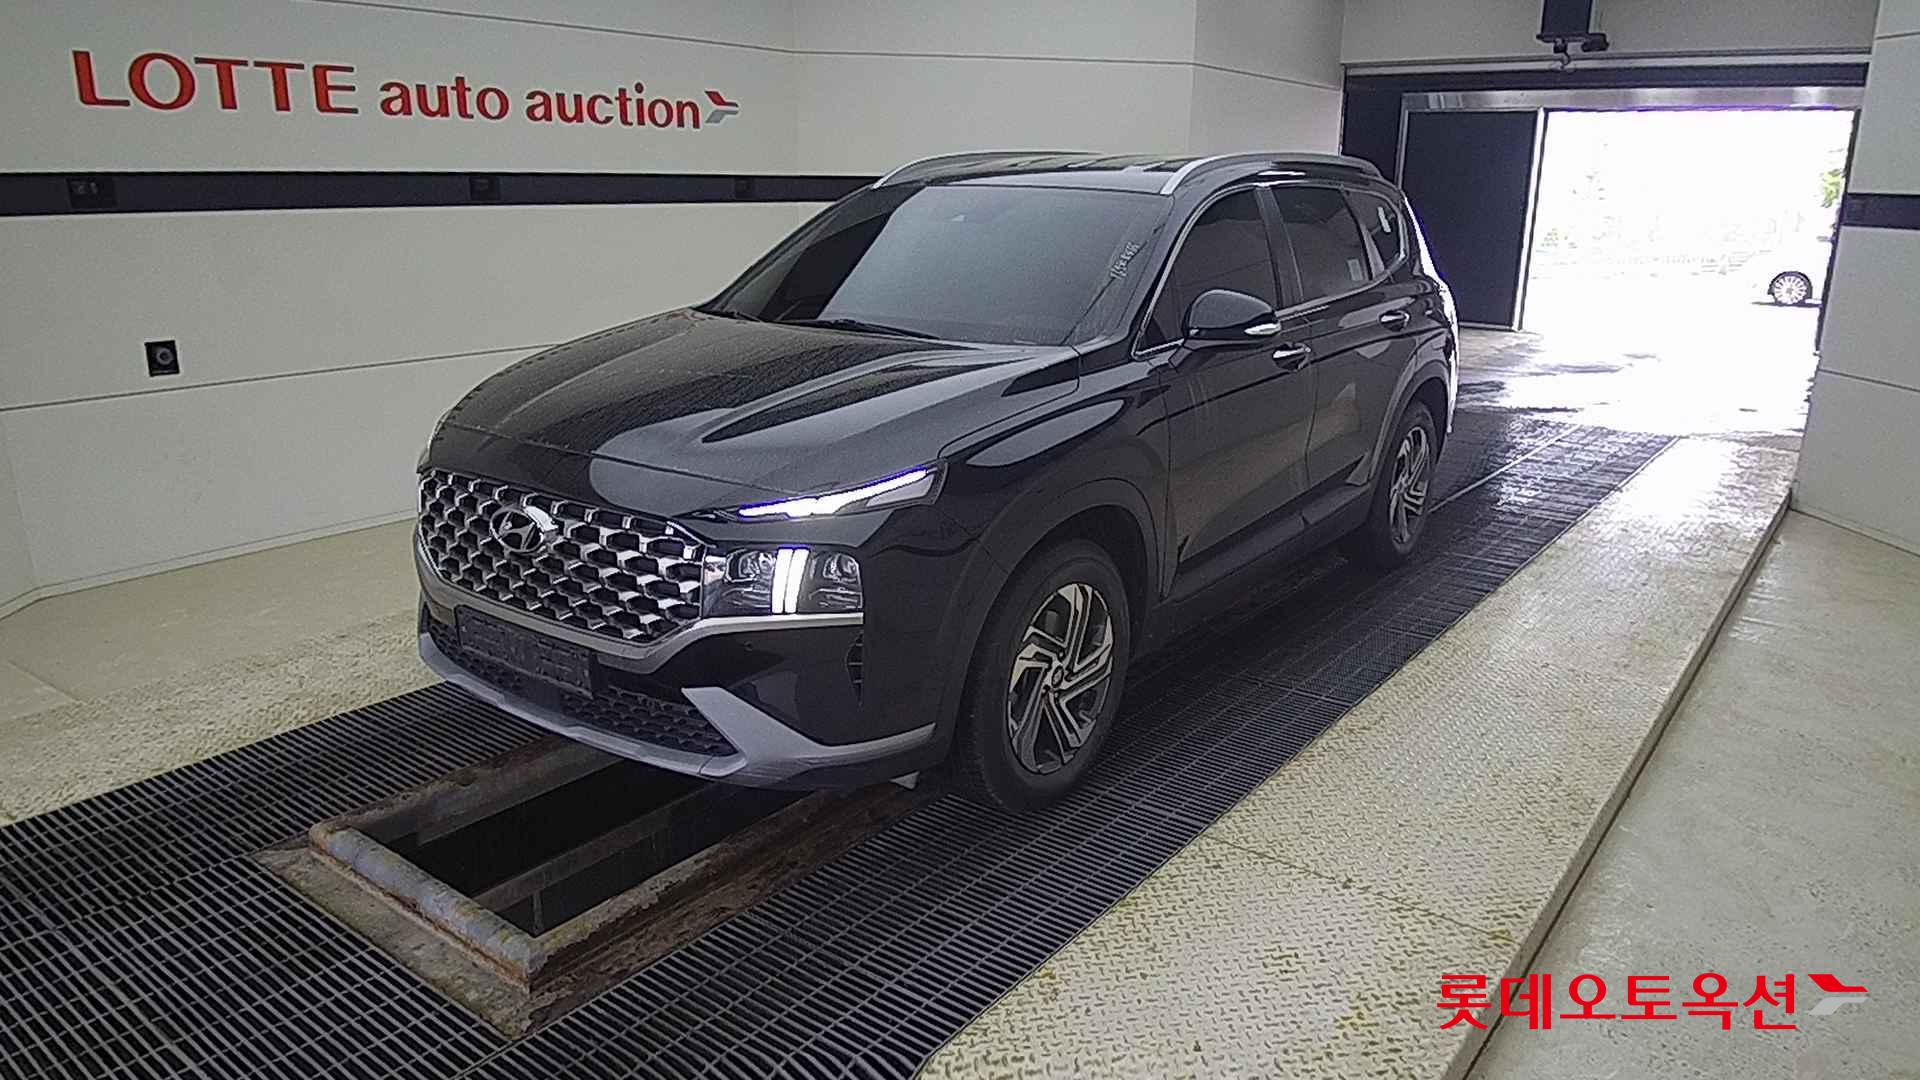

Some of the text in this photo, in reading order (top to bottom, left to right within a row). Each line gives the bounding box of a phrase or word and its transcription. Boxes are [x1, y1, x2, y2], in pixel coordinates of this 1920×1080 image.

[73, 49, 701, 130] LOTTE auto auction
